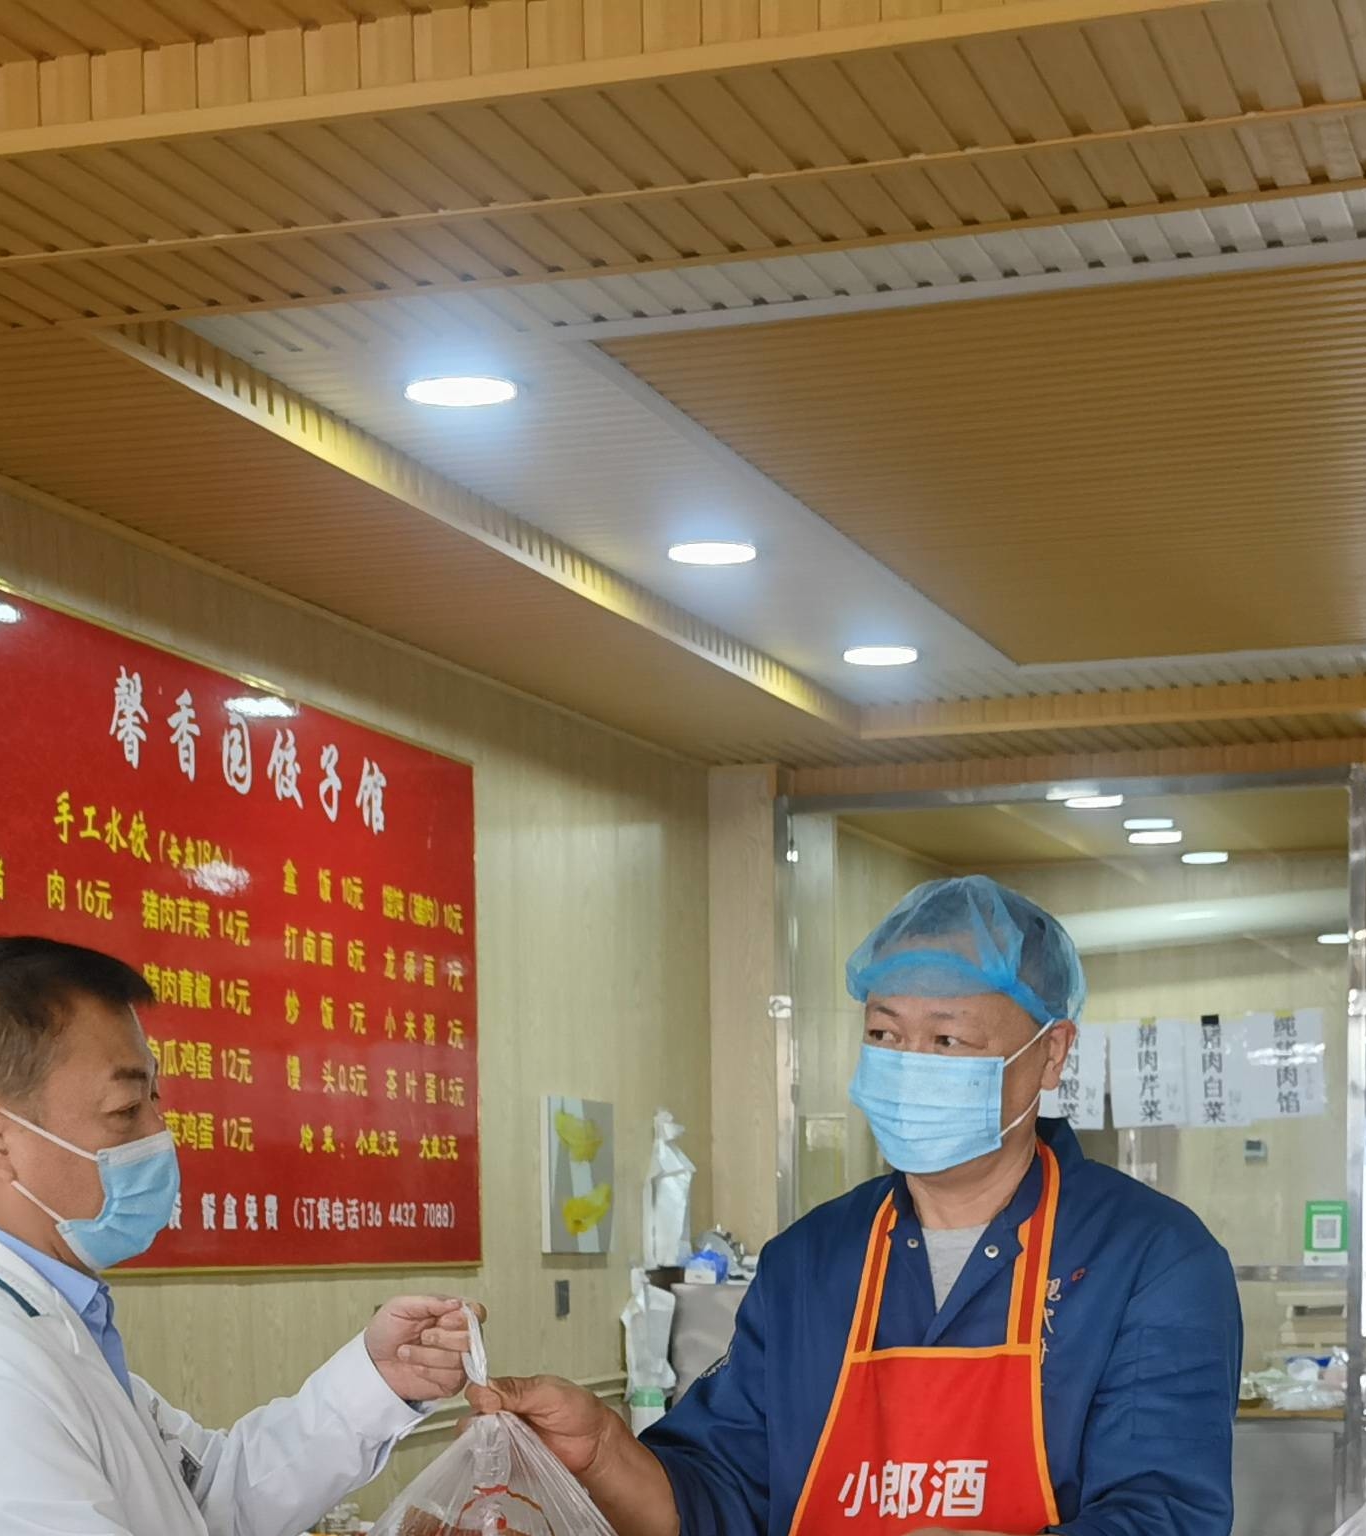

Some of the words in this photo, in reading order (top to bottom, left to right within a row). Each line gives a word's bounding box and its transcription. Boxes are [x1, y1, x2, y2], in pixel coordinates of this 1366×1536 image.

[142, 888, 211, 939] 猪肉芹菜
[218, 909, 251, 946] 14元
[219, 979, 251, 1016] 14元
[221, 1048, 253, 1084] 12元
[222, 1116, 255, 1152] 12元
[837, 1459, 988, 1519] 小郎酒
